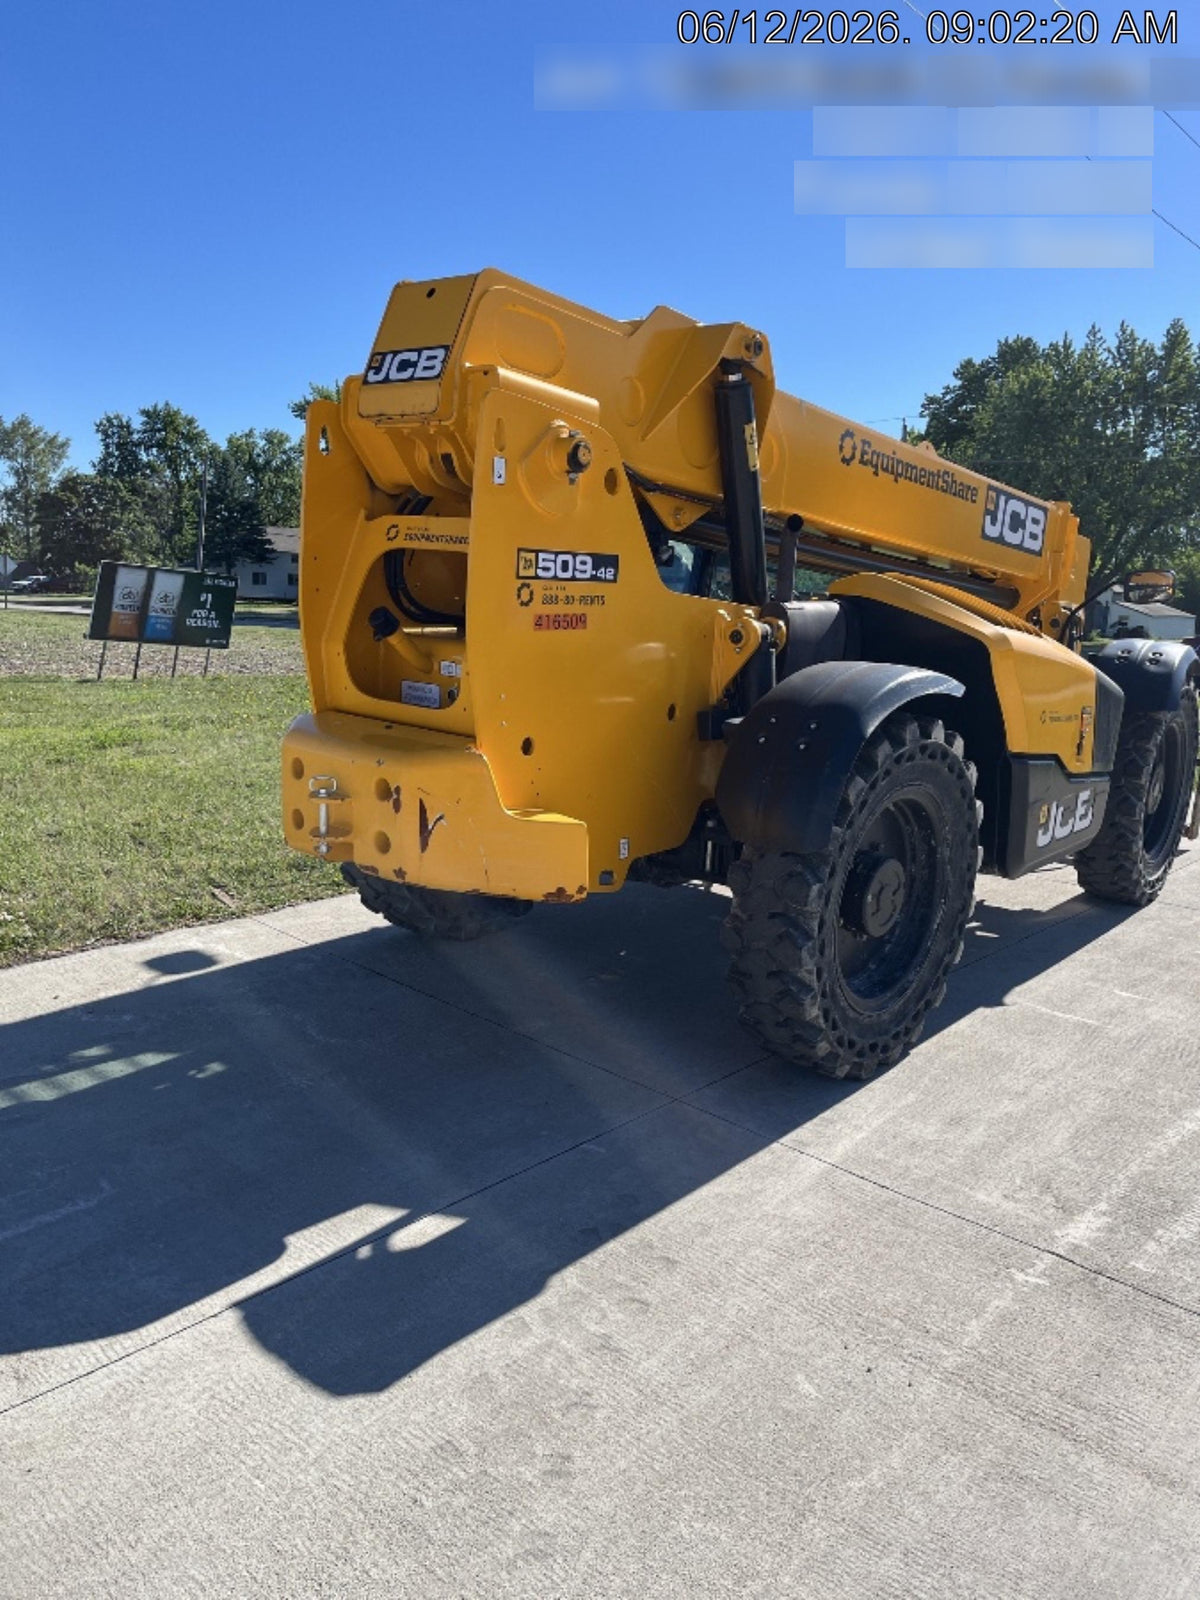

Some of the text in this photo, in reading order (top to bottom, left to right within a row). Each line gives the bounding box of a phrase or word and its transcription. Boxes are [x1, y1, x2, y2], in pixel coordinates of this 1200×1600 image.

[366, 347, 447, 383] JCB
[858, 438, 979, 503] EquipmentShare
[984, 494, 1047, 552] JCB
